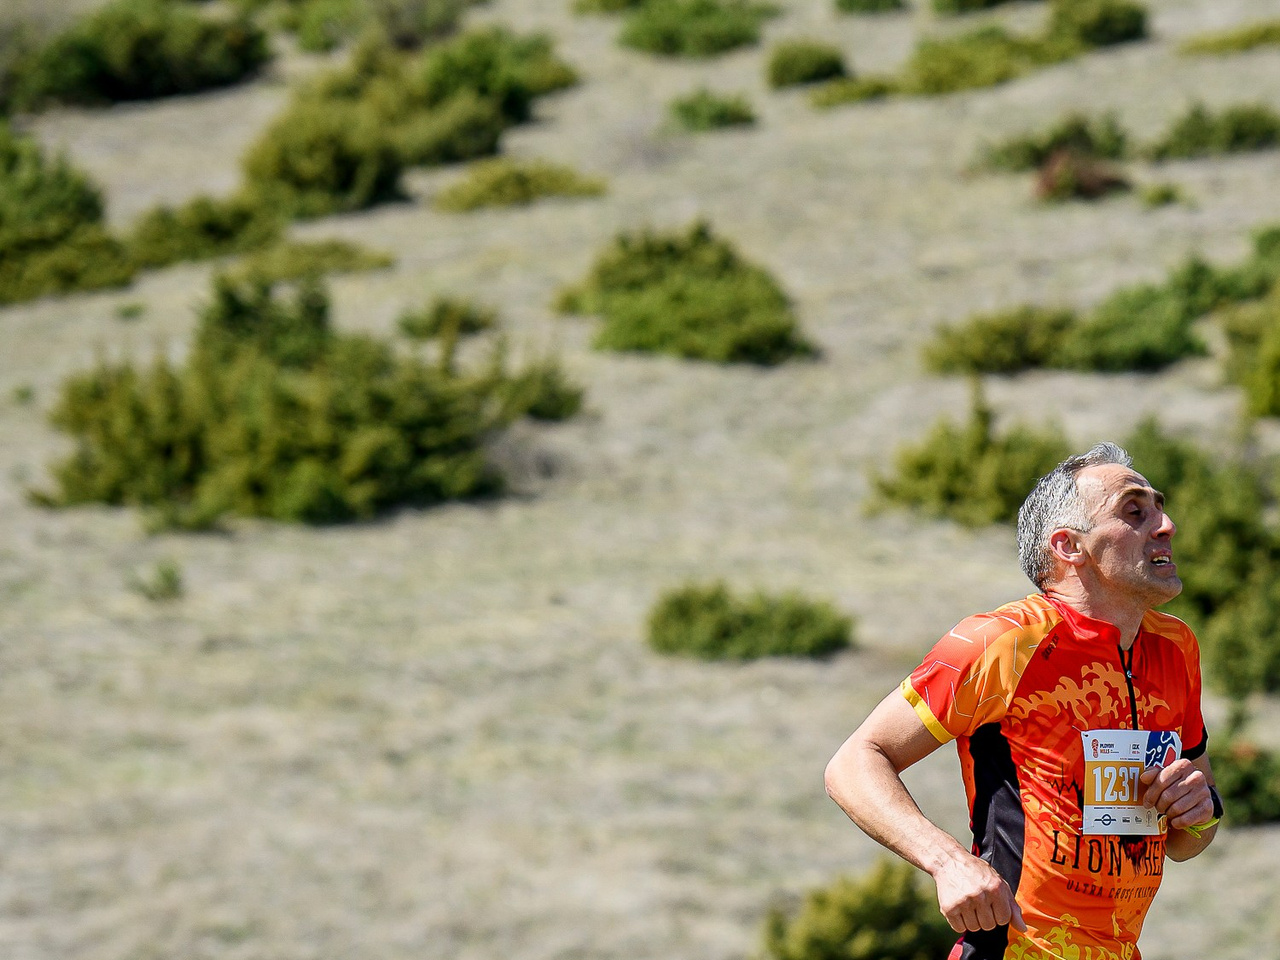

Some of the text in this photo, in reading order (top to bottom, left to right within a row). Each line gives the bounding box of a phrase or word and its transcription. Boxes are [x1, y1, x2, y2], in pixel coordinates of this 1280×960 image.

[1093, 766, 1140, 802] 1237
[1050, 830, 1121, 877] LION
[1066, 880, 1103, 896] ULTRA
